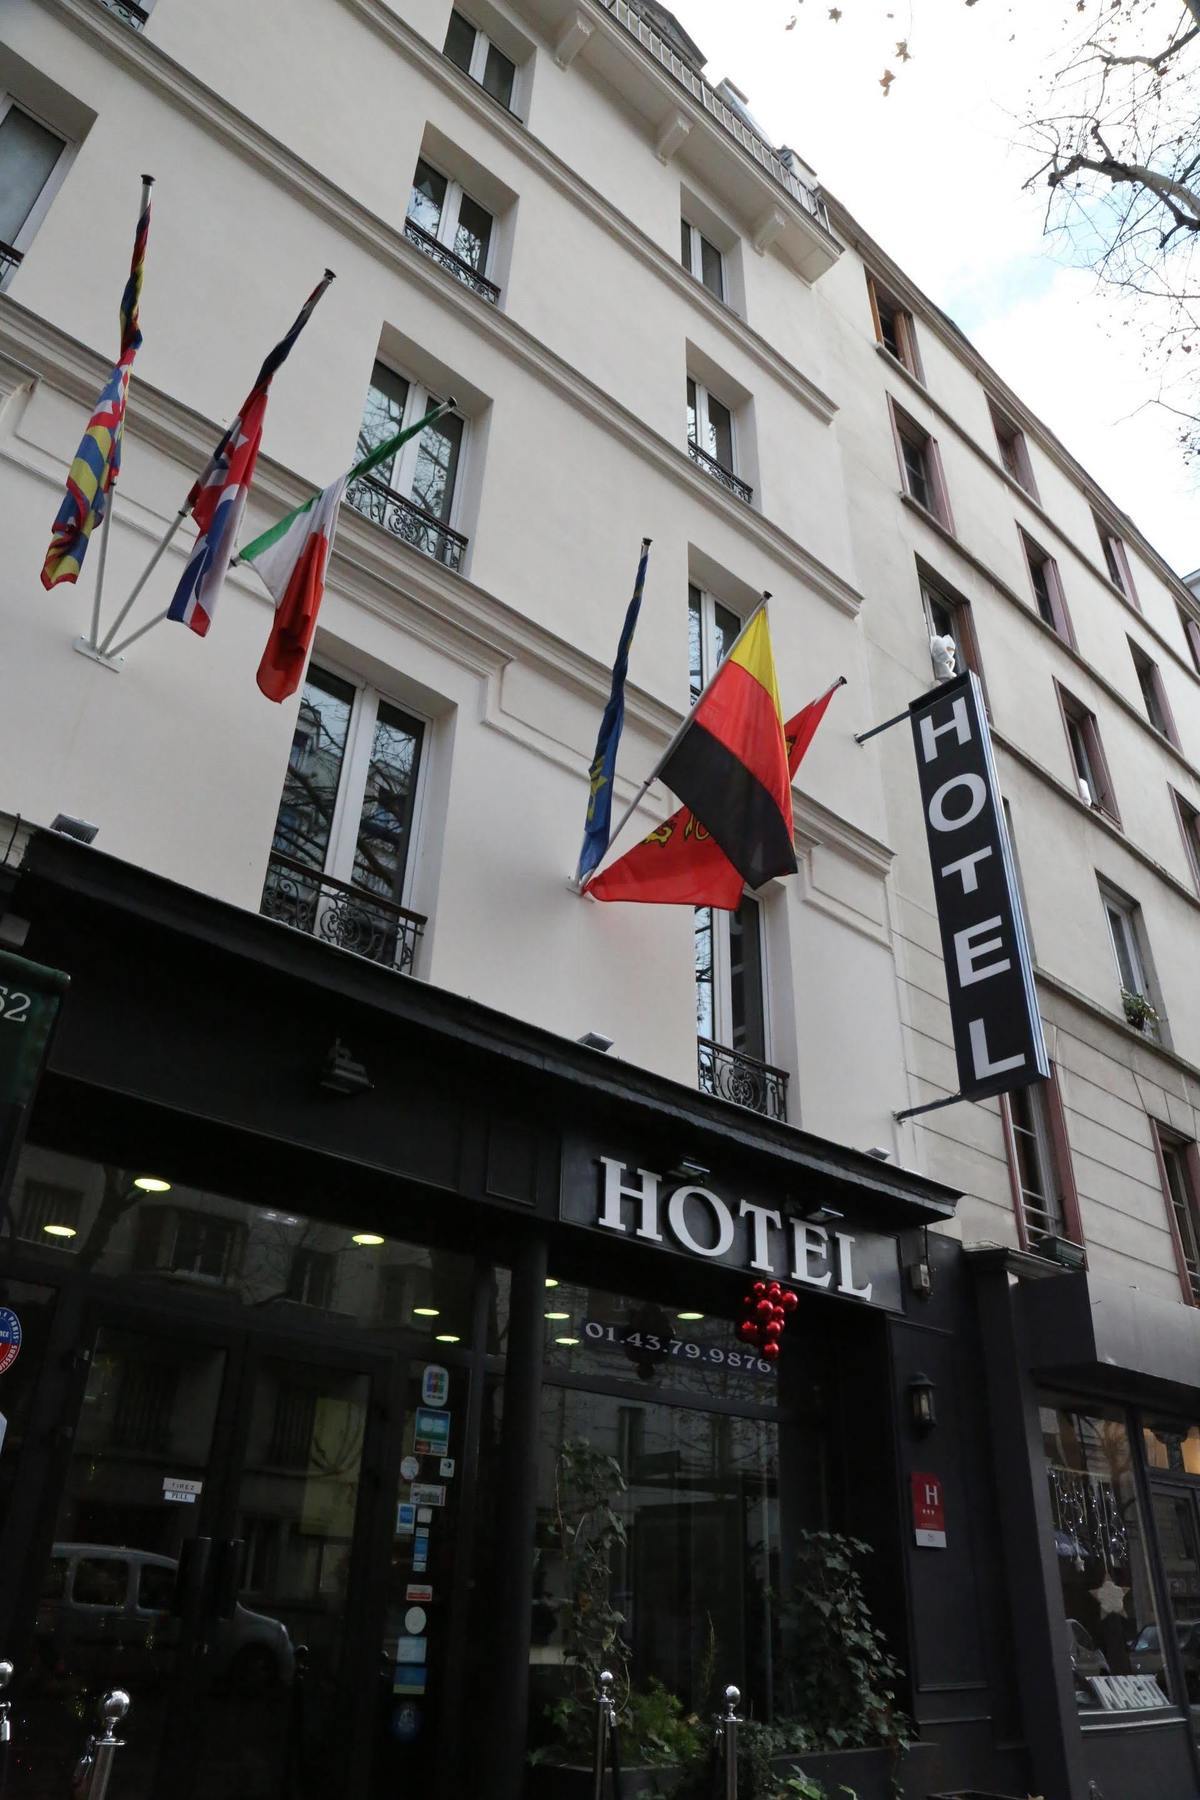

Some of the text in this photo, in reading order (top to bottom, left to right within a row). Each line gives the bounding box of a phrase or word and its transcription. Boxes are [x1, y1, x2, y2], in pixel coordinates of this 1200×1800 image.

[918, 695, 1026, 1081] HOTEL
[598, 1155, 873, 1302] HOTEL
[585, 1322, 772, 1374] 01.43.79.9876
[925, 1484, 939, 1506] H
